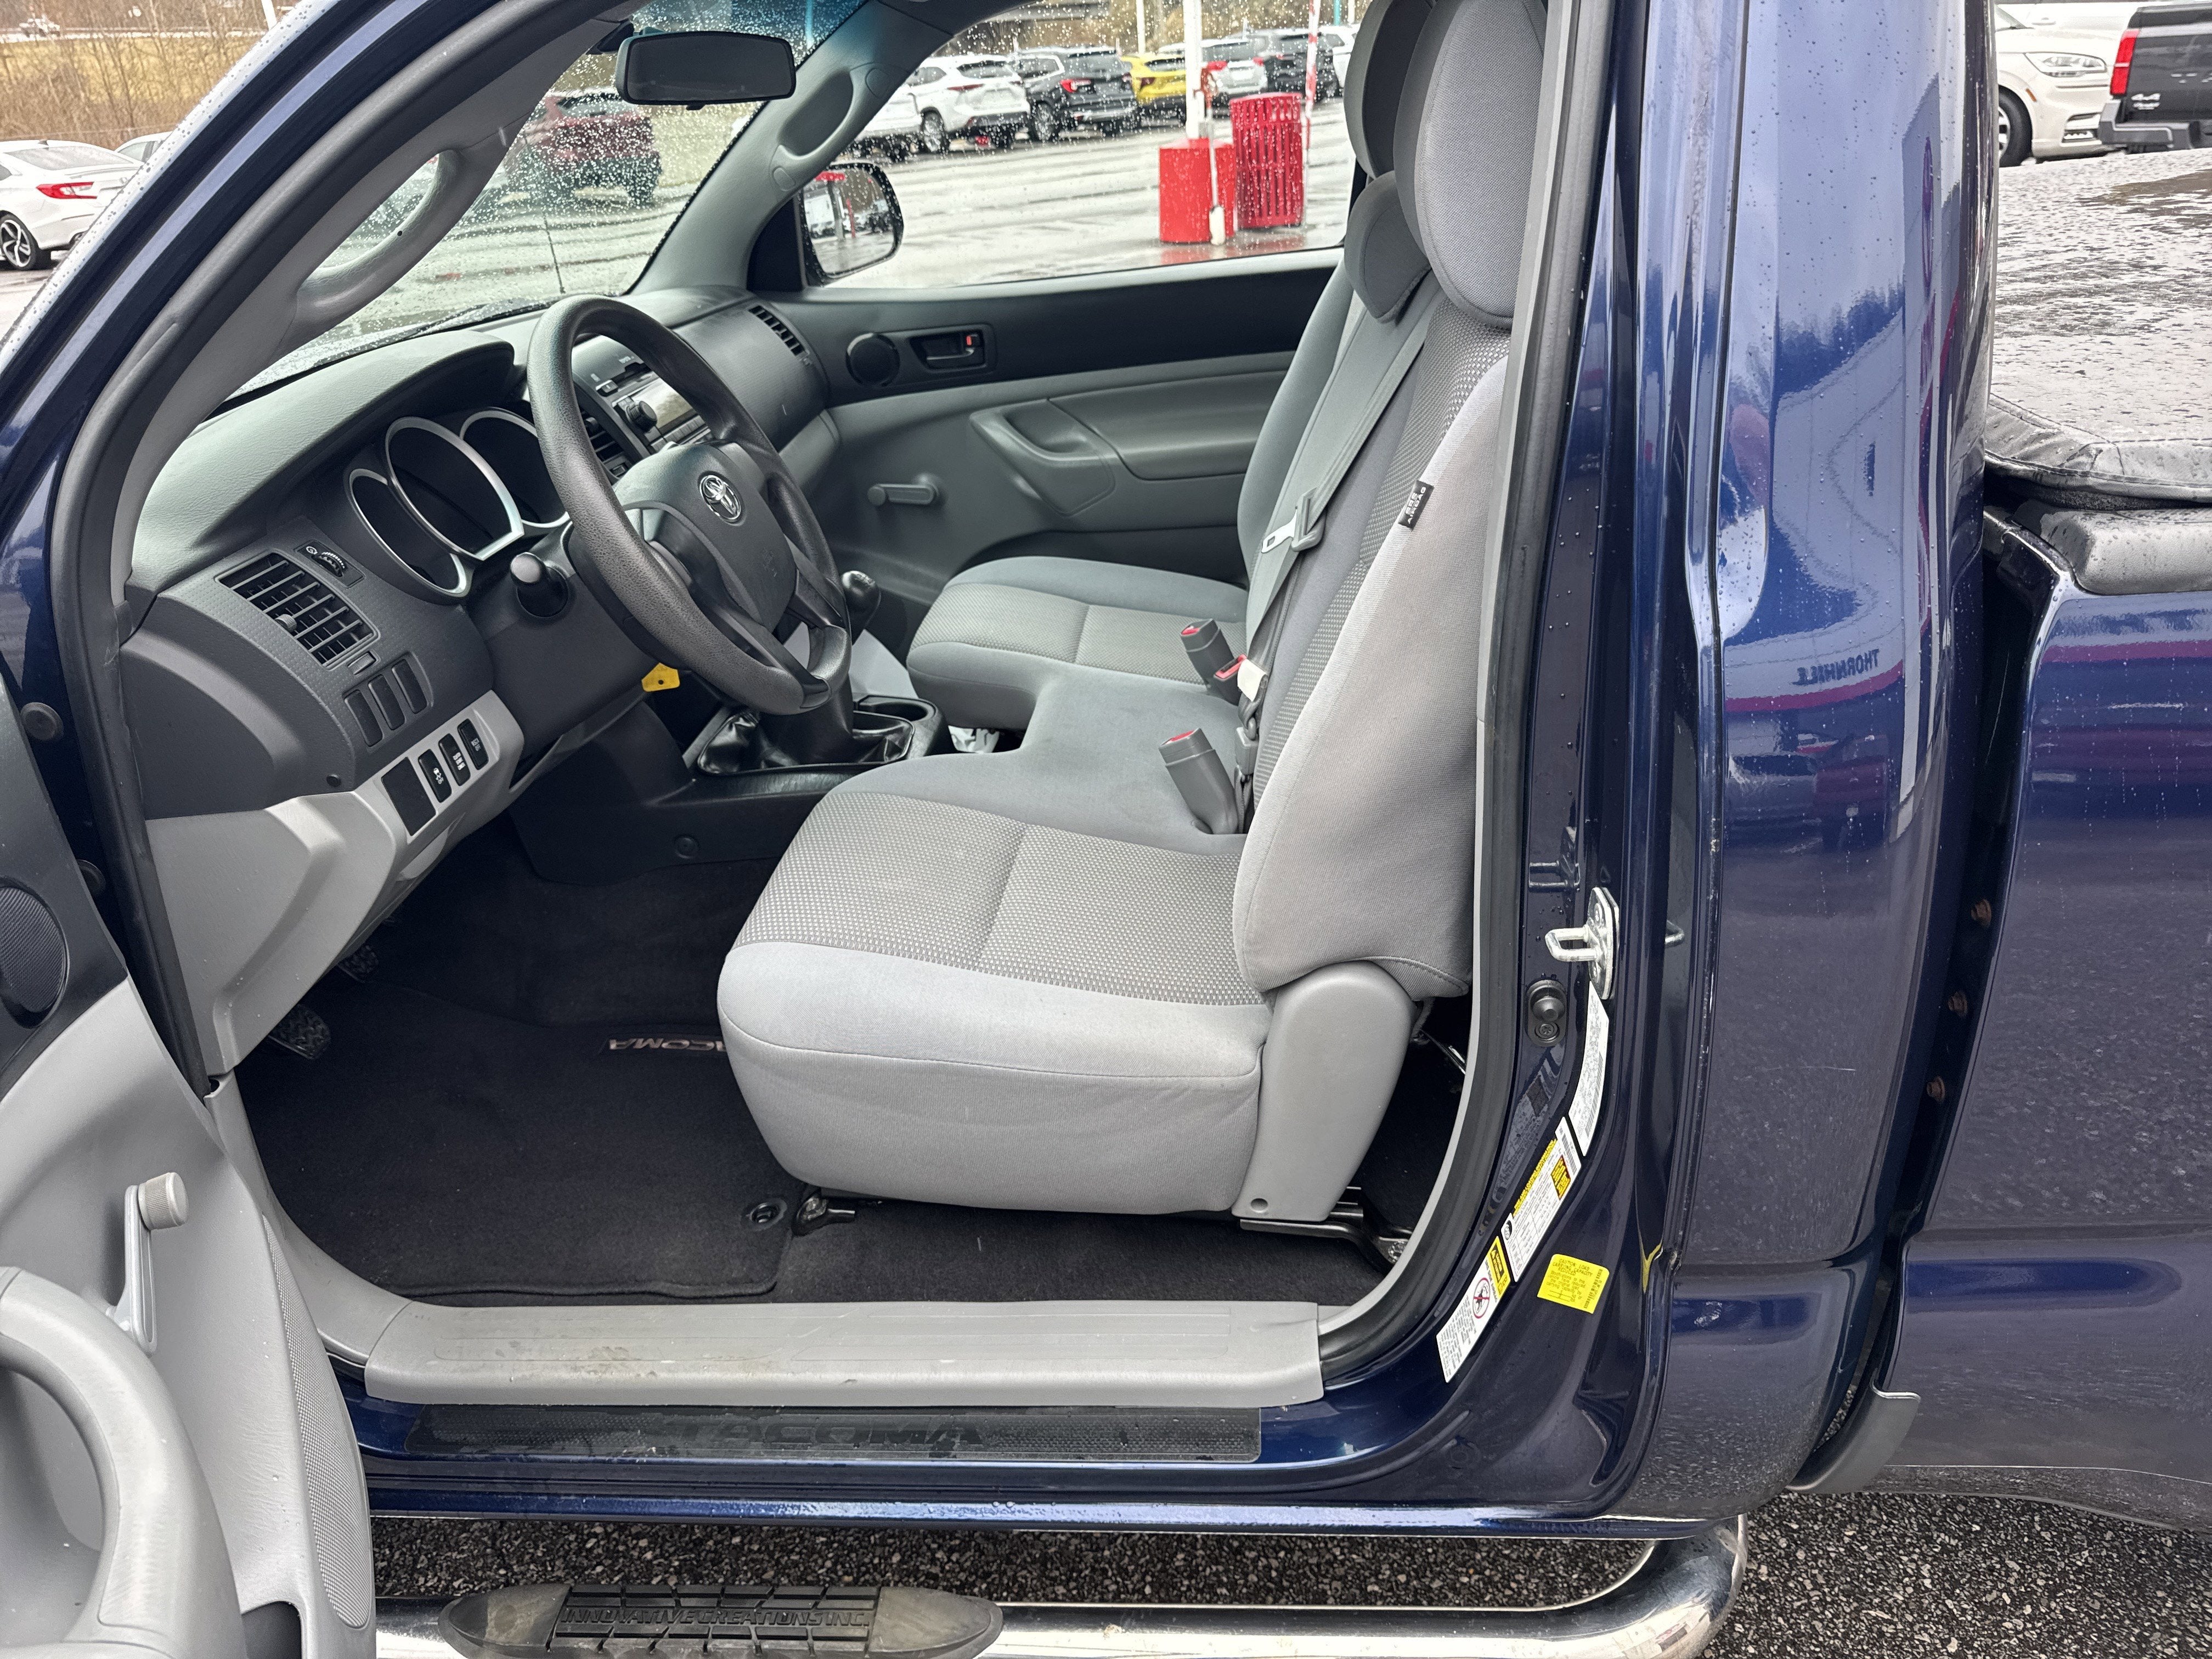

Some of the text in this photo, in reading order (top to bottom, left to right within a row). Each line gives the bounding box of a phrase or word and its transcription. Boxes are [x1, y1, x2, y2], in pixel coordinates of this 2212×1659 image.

[1405, 492, 1418, 515] SRS
[1407, 486, 1426, 525] AIRBAG
[1573, 1268, 1593, 1277] CAPACITY
[668, 1420, 982, 1444] TACOMA
[560, 1608, 871, 1627] INNOVATIVE CREATIONS INC.
